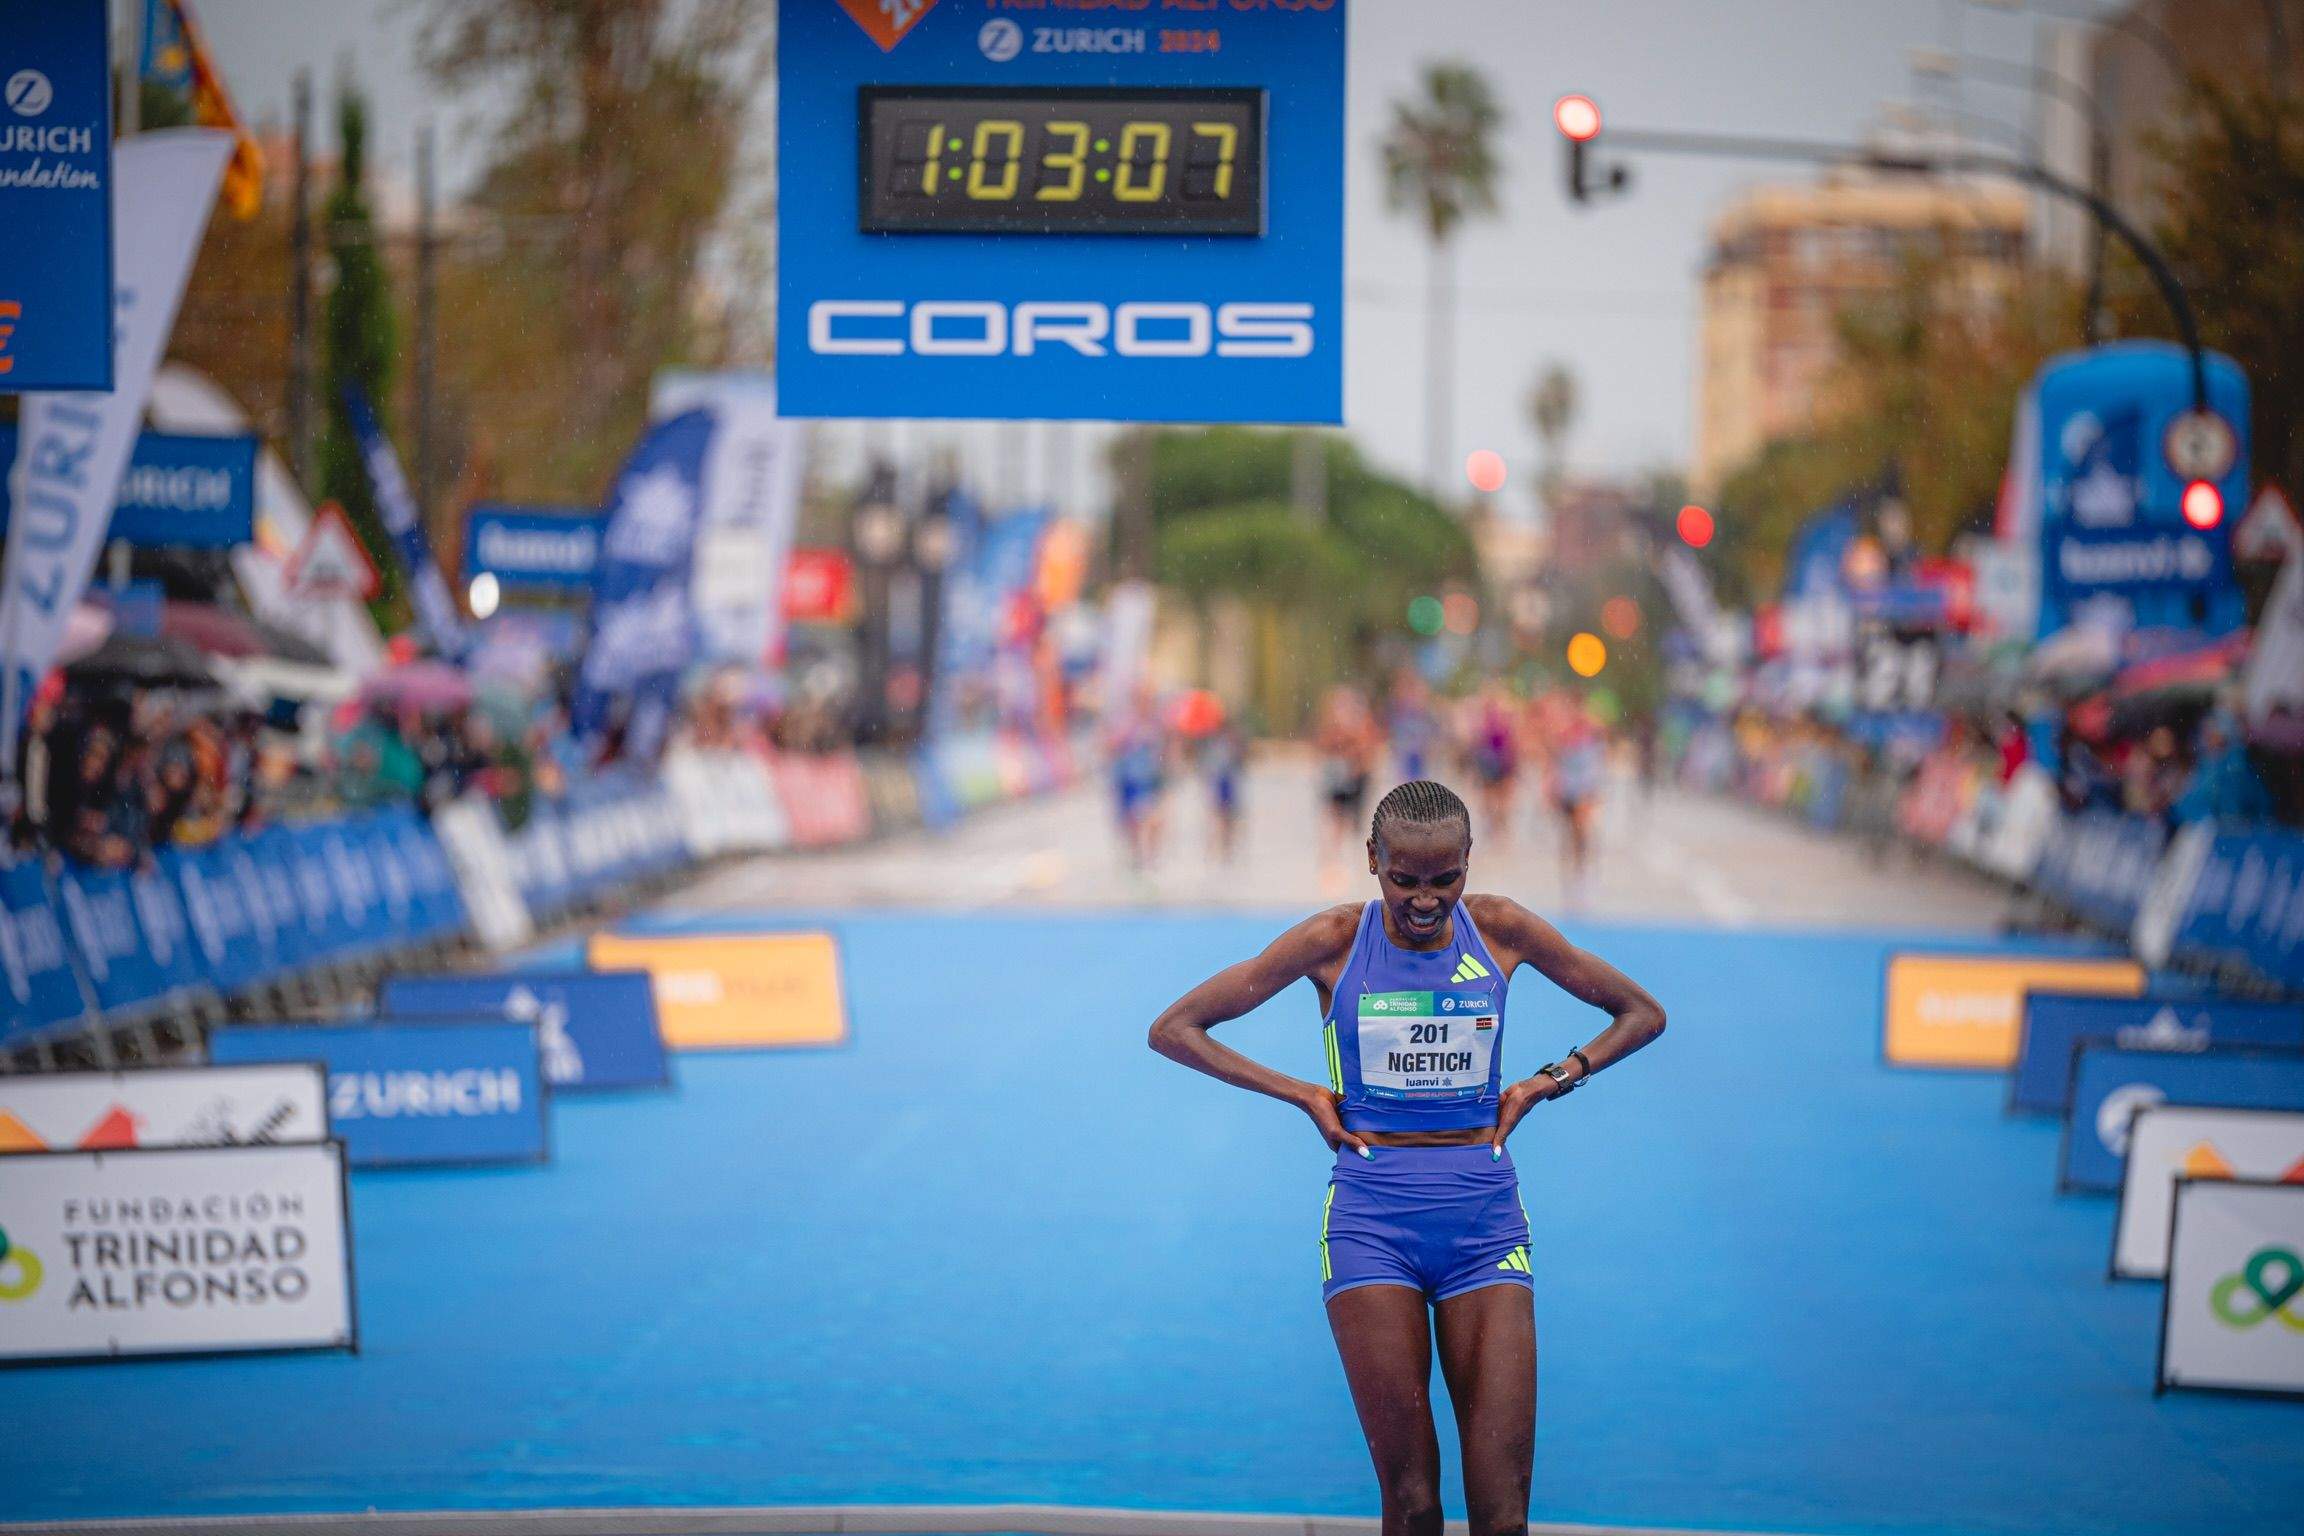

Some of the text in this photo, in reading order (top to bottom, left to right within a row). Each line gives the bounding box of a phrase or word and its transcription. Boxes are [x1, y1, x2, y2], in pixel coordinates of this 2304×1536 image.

[1033, 27, 1145, 53] ZURICH
[921, 120, 1238, 202] 1:03:07
[808, 301, 1315, 358] COROS
[1459, 1000, 1489, 1008] ZURICH
[1410, 1024, 1448, 1044] 201
[1388, 1052, 1472, 1073] NGETICH
[329, 1068, 521, 1119] ZURICH
[1406, 1077, 1439, 1087] luanvi
[62, 1225, 307, 1269] TRINIDAD
[67, 1264, 309, 1312] ALFONSO
